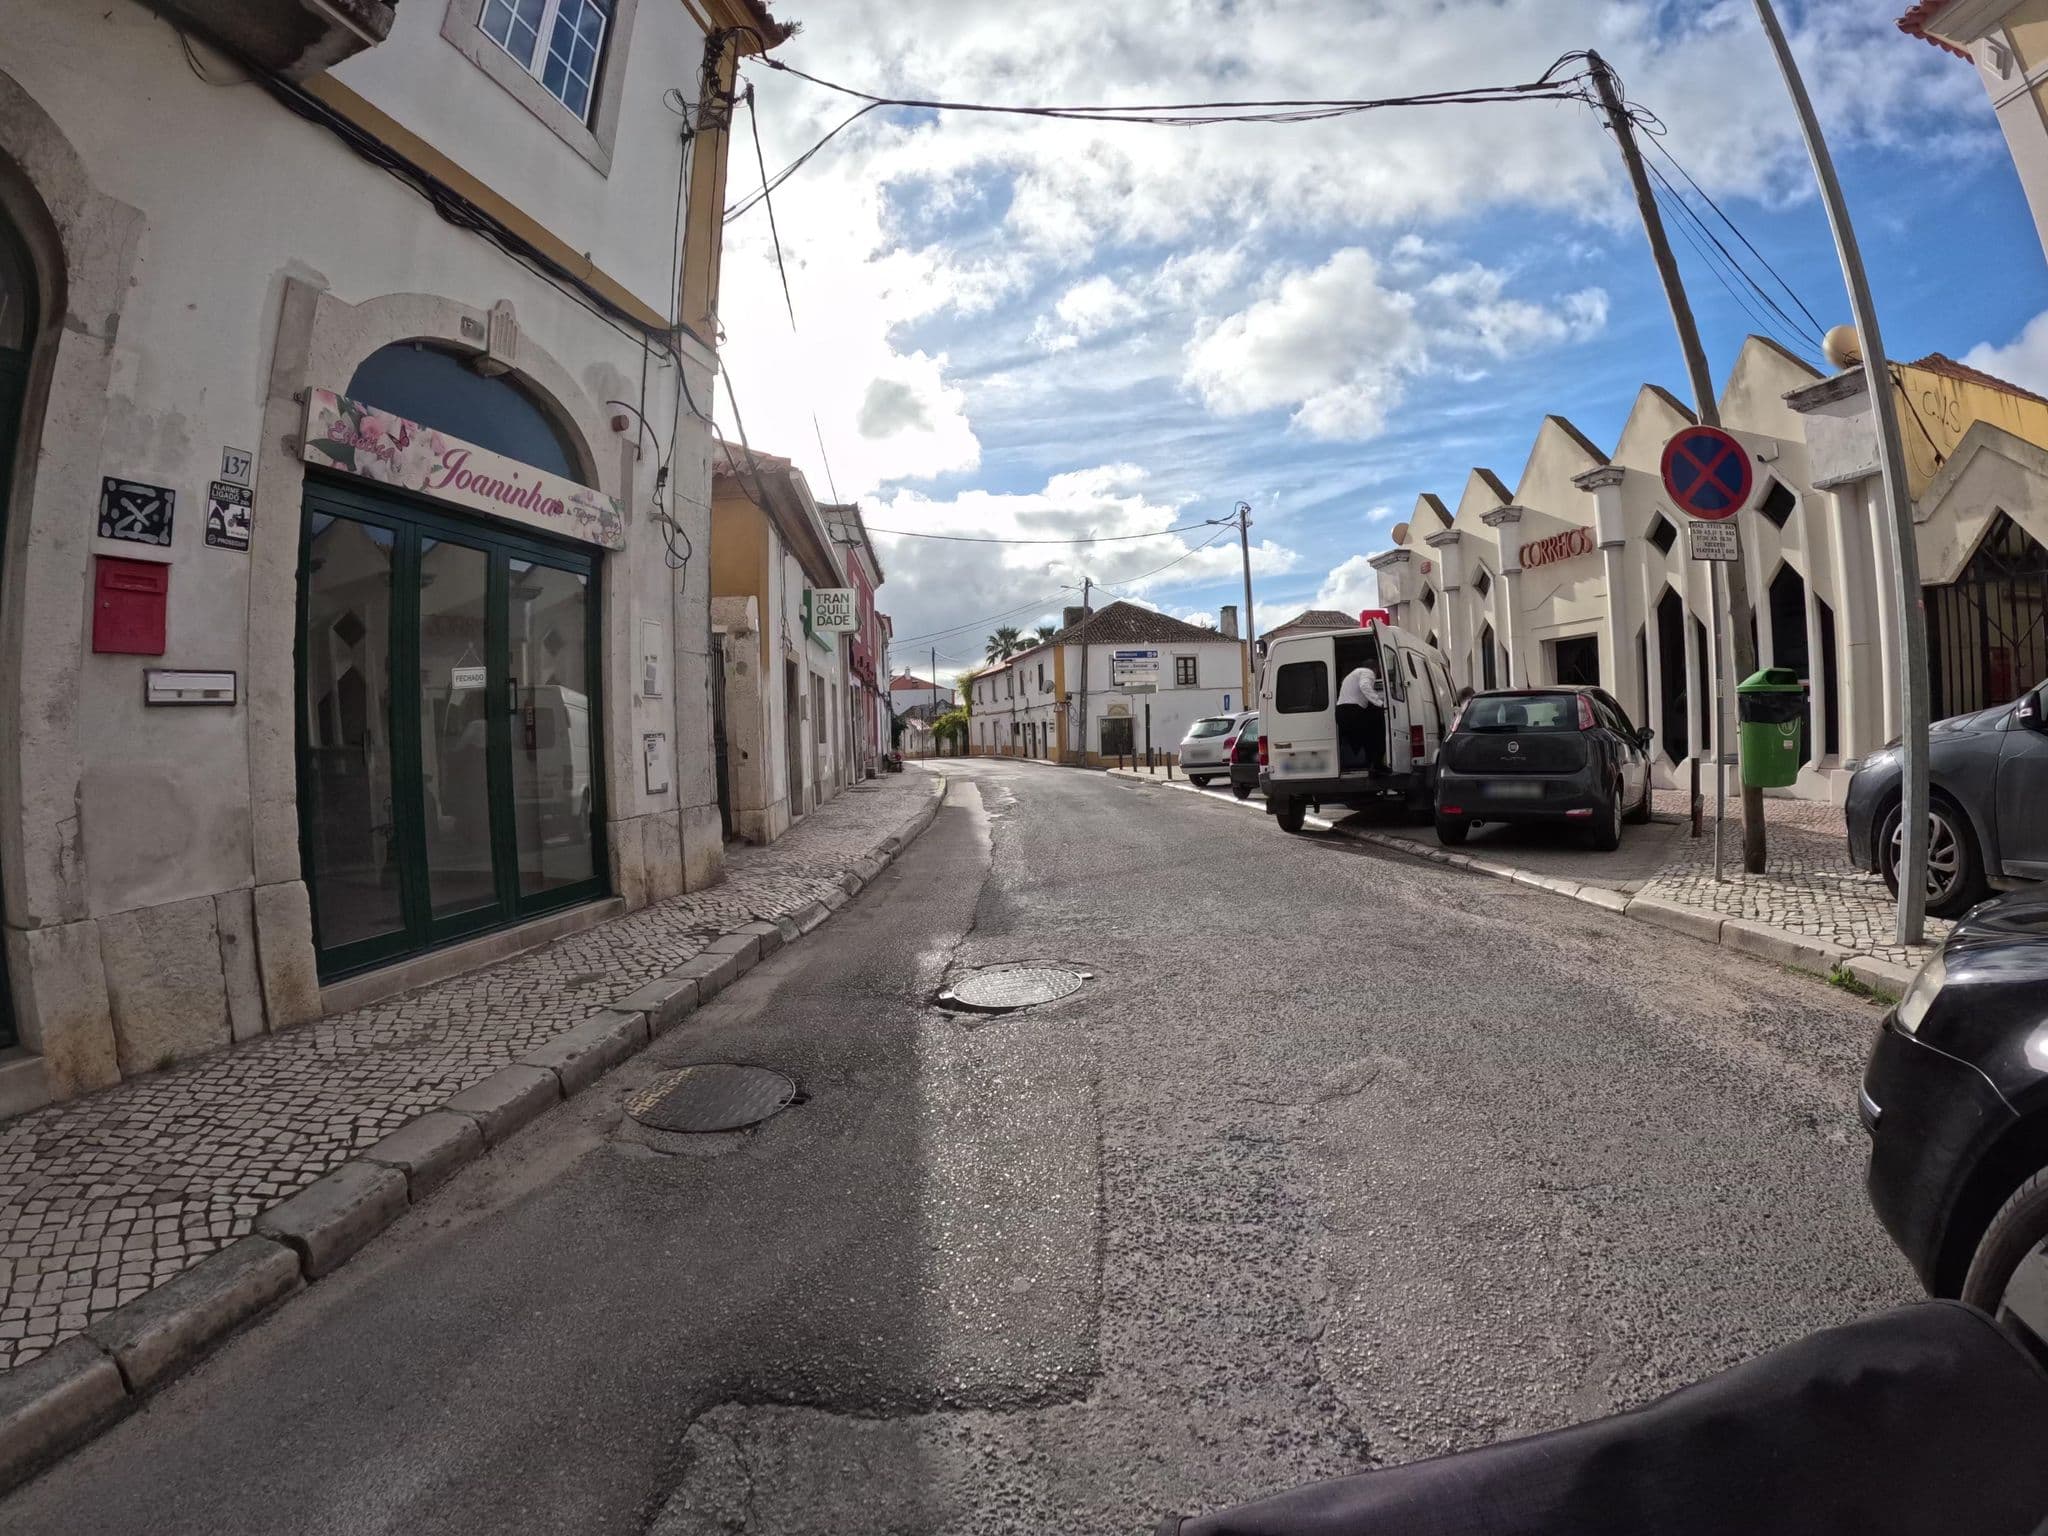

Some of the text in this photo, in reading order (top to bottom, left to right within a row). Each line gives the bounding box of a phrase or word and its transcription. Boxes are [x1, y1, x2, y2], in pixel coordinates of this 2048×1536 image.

[223, 455, 250, 478] 137
[213, 482, 241, 495] ALARME
[424, 448, 563, 517] Joaninha
[211, 489, 240, 501] LIGADO
[1519, 526, 1593, 569] CORREIOS
[816, 593, 849, 604] TRAN
[816, 604, 849, 616] QUILI
[817, 615, 850, 626] DADE
